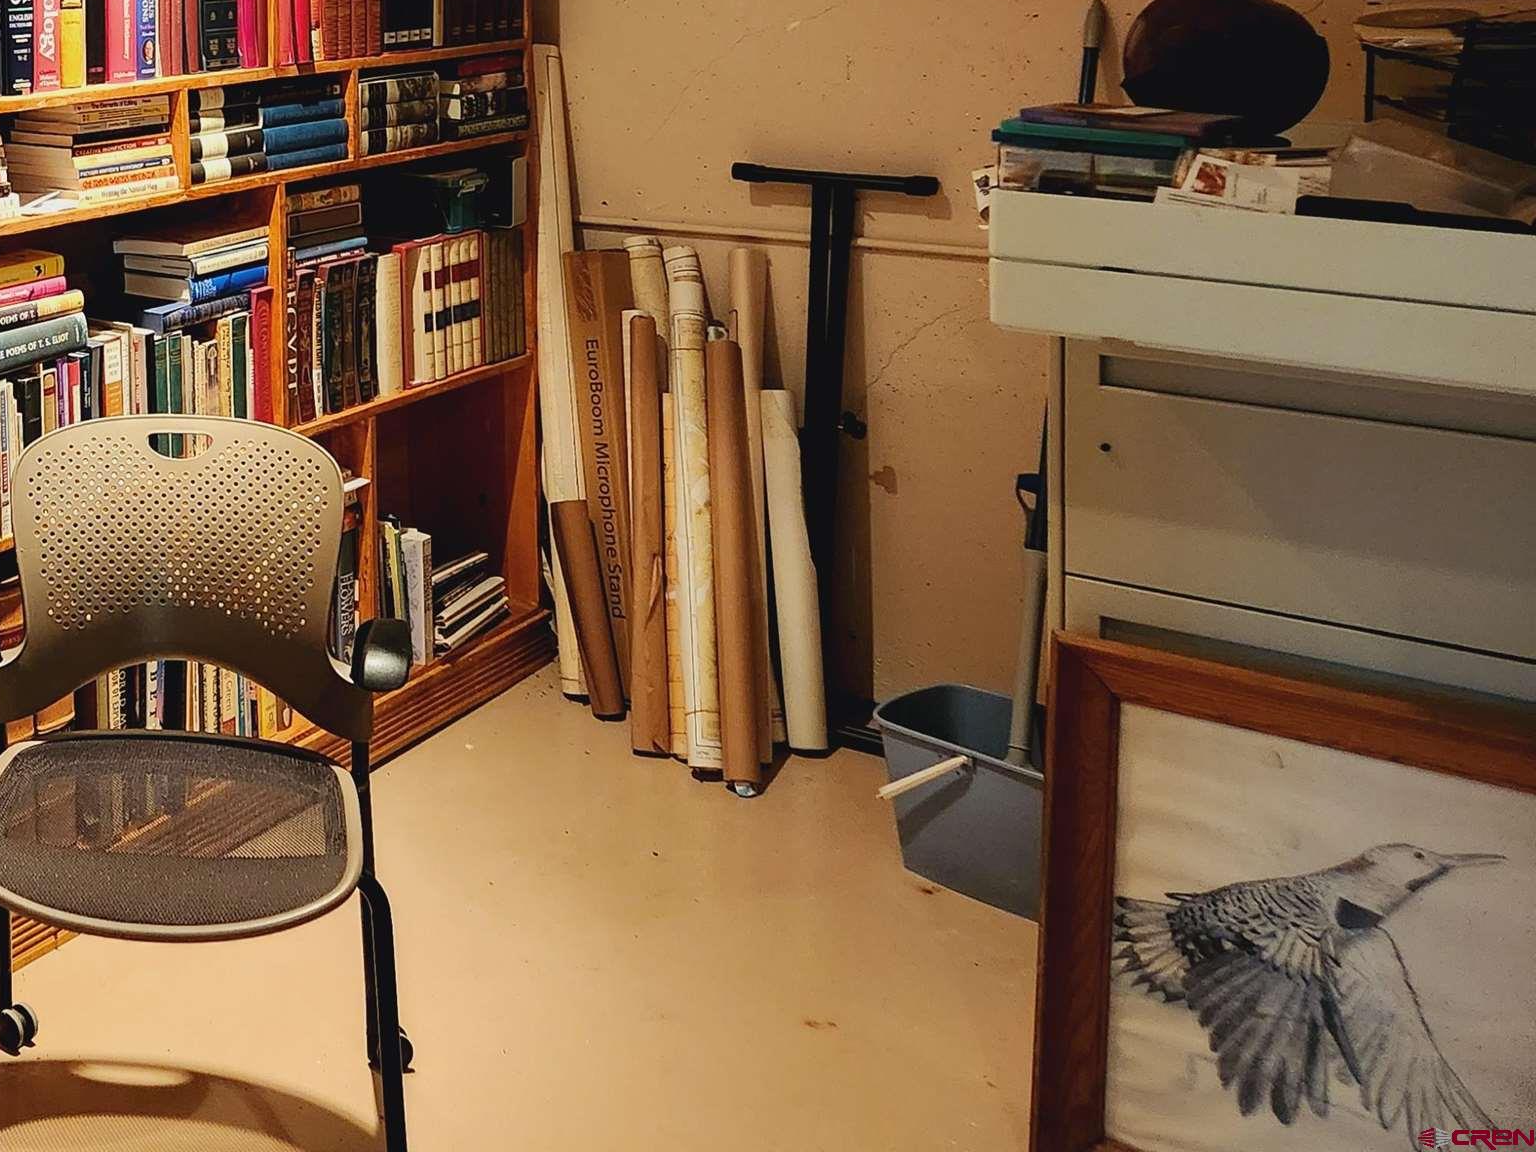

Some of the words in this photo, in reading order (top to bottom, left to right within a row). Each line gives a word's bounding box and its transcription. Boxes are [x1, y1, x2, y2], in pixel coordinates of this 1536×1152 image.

[9, 13, 33, 23] ENGLISH
[19, 313, 30, 323] OF
[5, 345, 27, 360] POEMS
[27, 342, 38, 354] OF
[37, 341, 44, 351] T.
[44, 339, 52, 349] S.
[52, 332, 70, 347] ELIOT
[585, 338, 605, 436] EuroBoom
[594, 441, 618, 559] Microphone
[606, 562, 627, 623] Stand
